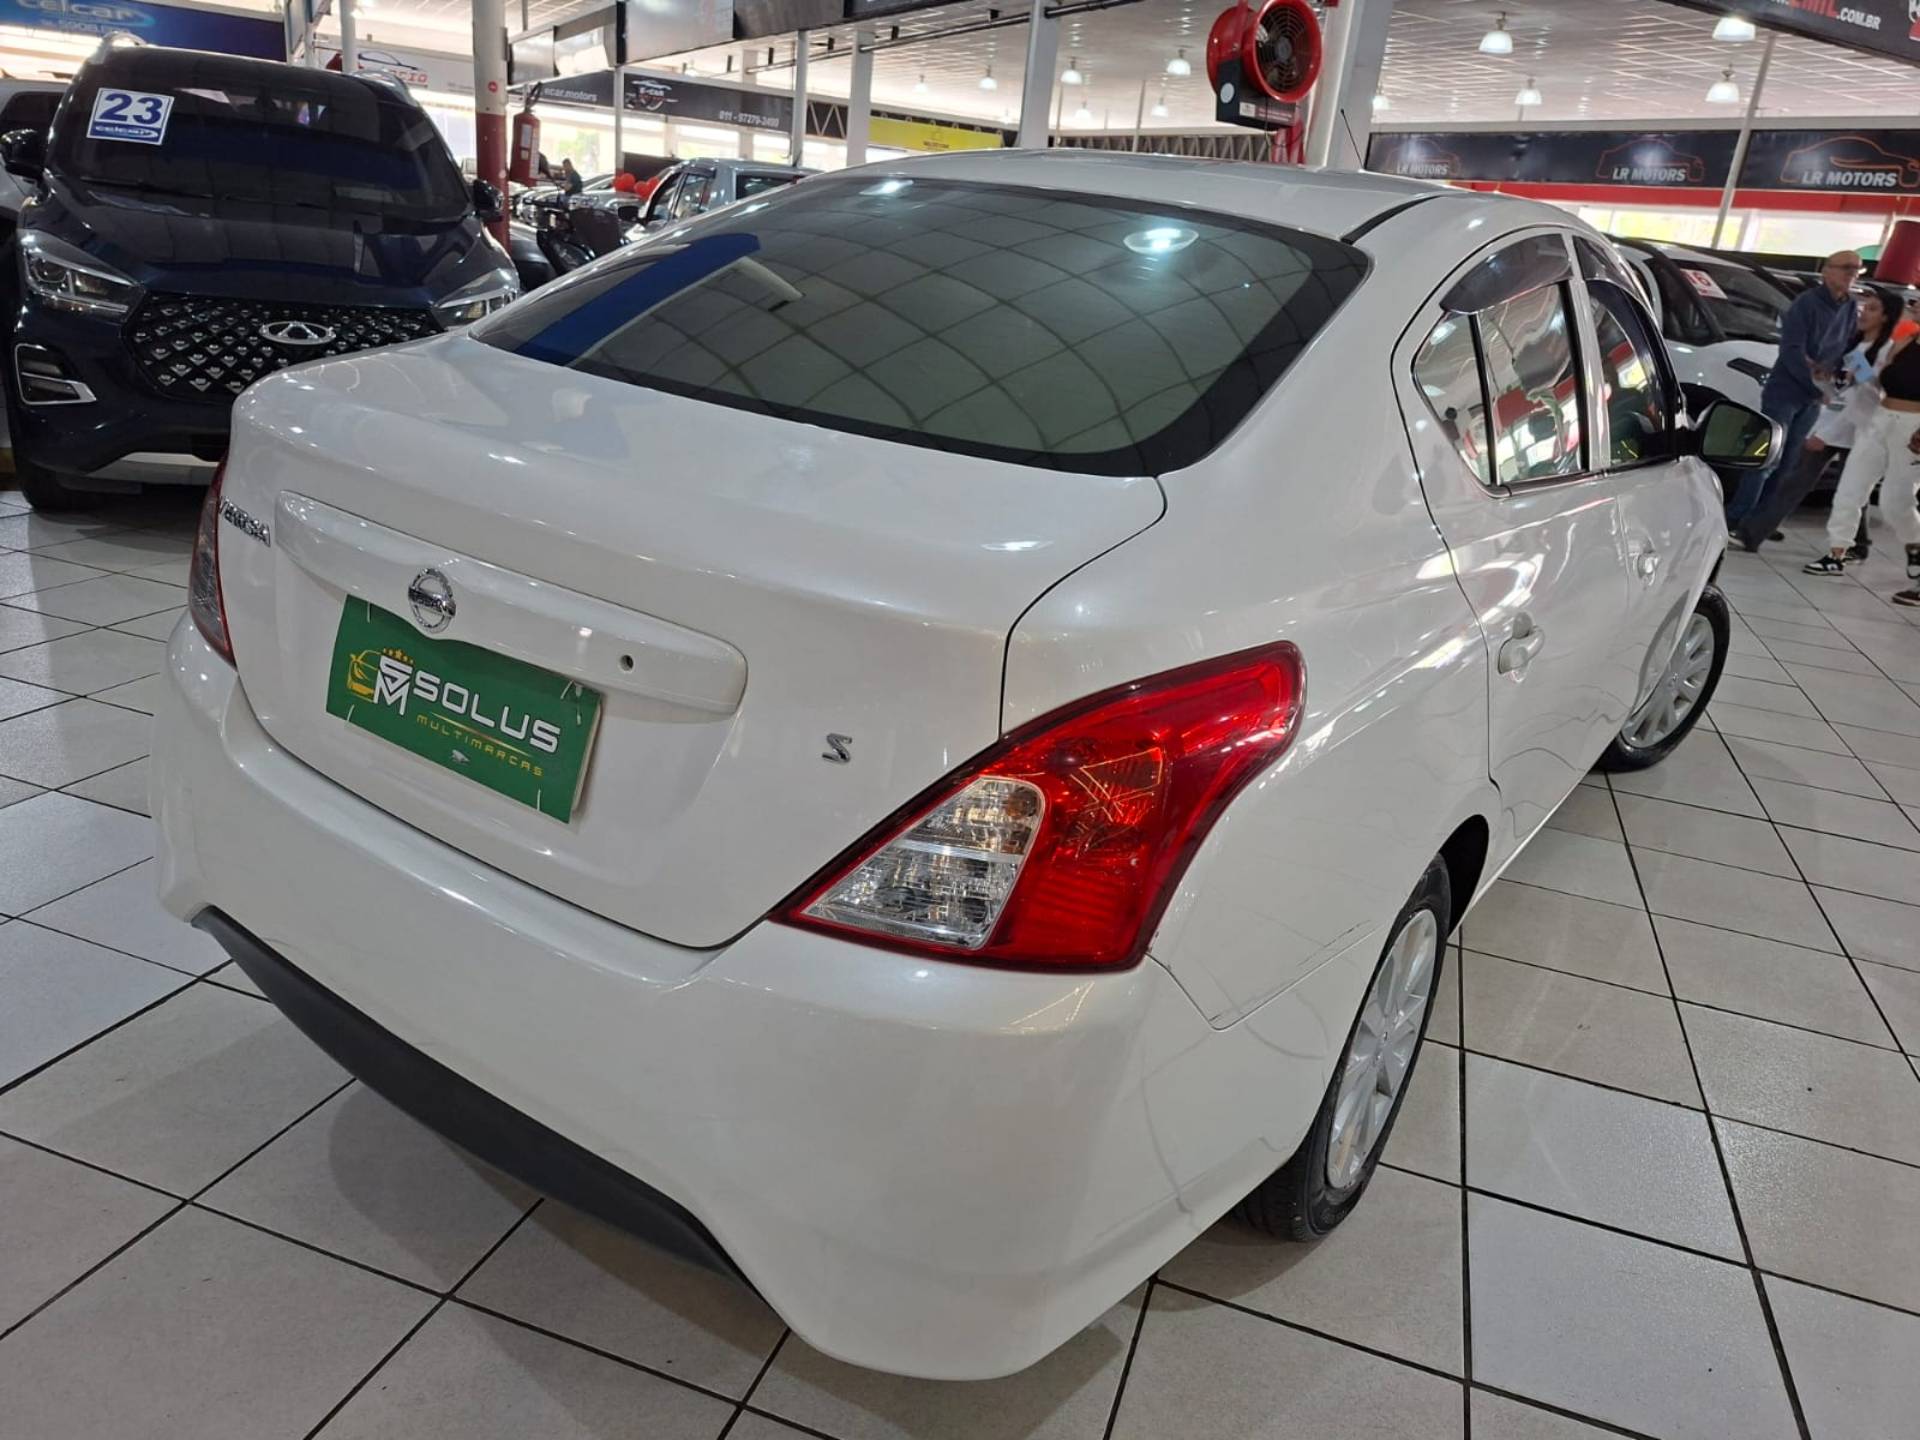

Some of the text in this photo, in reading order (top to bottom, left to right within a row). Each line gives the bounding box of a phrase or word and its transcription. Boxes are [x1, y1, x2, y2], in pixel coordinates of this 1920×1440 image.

[100, 93, 162, 125] 23
[1612, 167, 1687, 182] LR MOTORS
[1801, 170, 1897, 188] LR MOTORS
[413, 669, 561, 753] SOLUS
[822, 732, 852, 765] S
